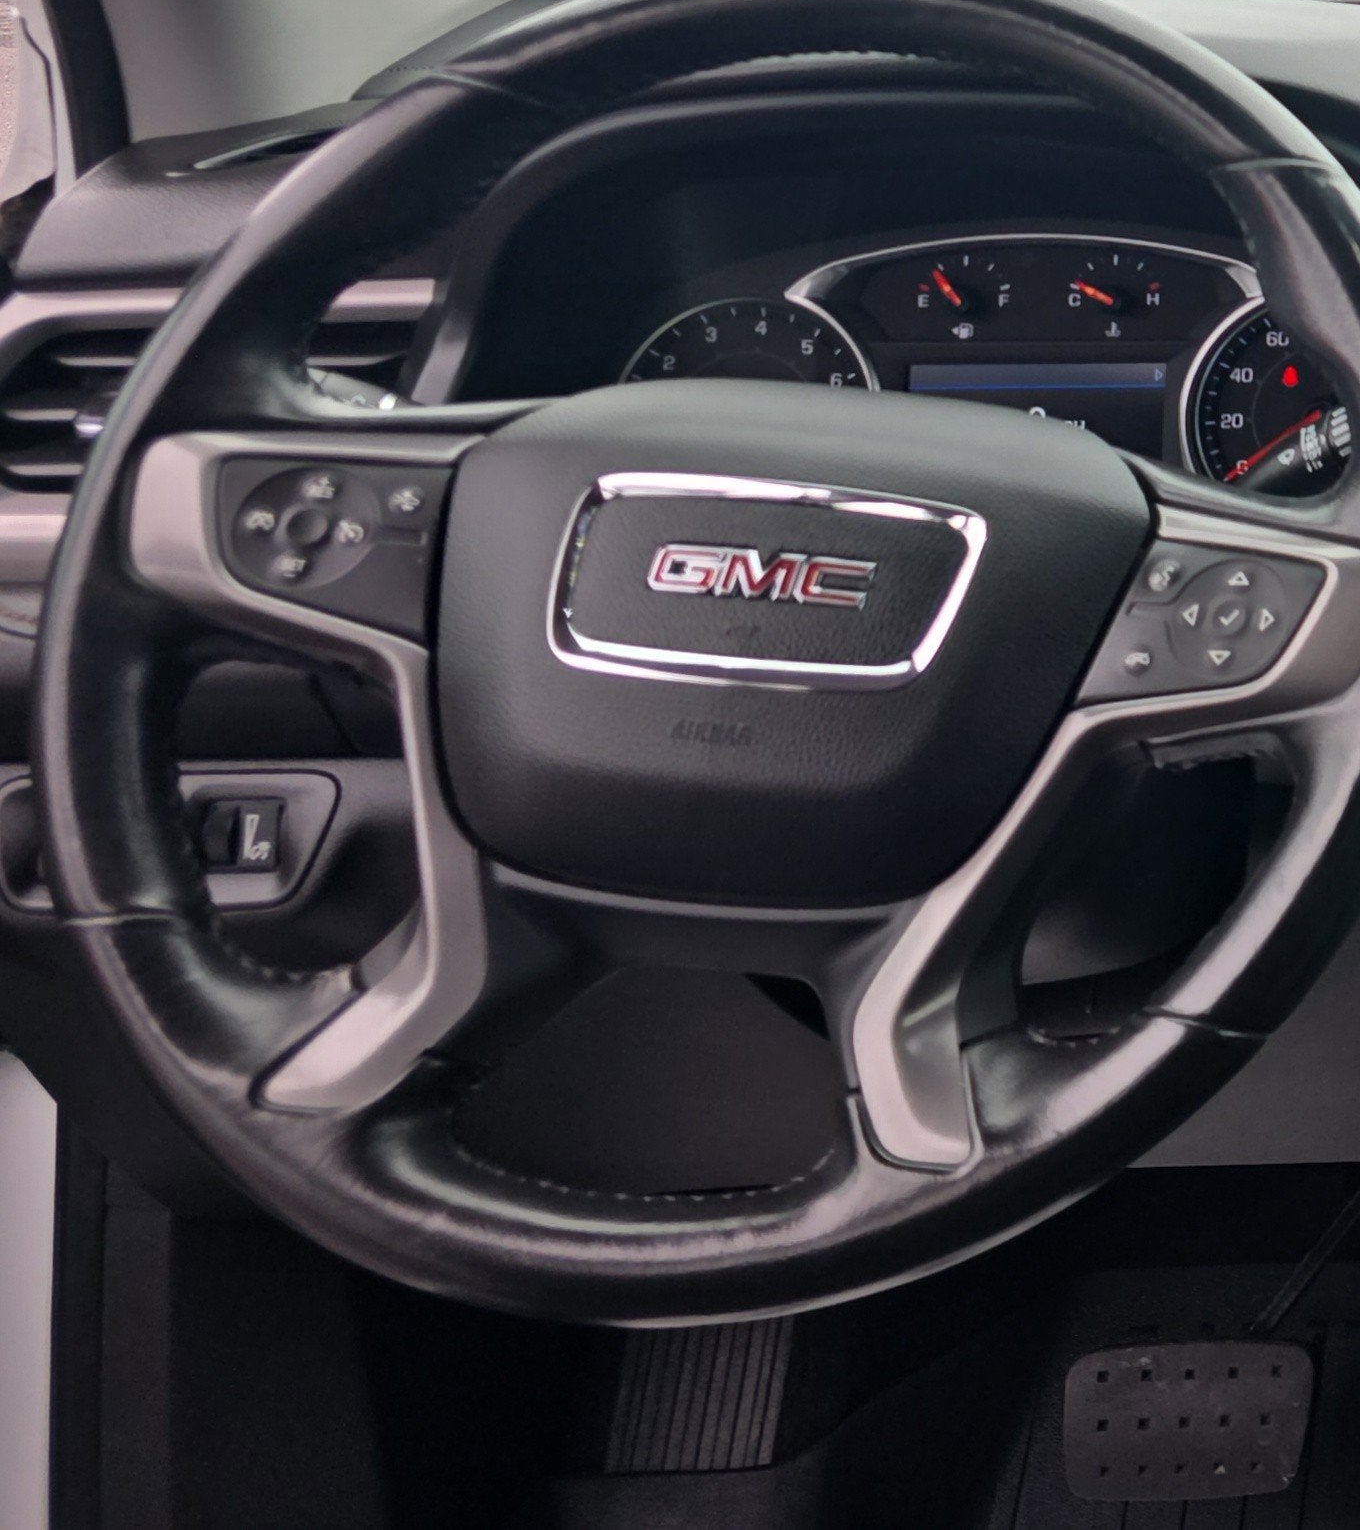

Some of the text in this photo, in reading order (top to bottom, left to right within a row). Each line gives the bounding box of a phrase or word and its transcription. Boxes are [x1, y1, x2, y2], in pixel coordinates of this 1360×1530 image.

[917, 293, 930, 308] E
[998, 293, 1010, 308] F
[1068, 293, 1082, 308] C
[1146, 293, 1160, 307] H
[705, 325, 718, 343] 3
[755, 320, 768, 336] 4
[801, 338, 814, 356] 5
[662, 354, 676, 371] 2
[829, 372, 843, 389] 6
[1229, 367, 1254, 383] 40
[1220, 413, 1244, 429] 20
[646, 542, 876, 611] GMC
